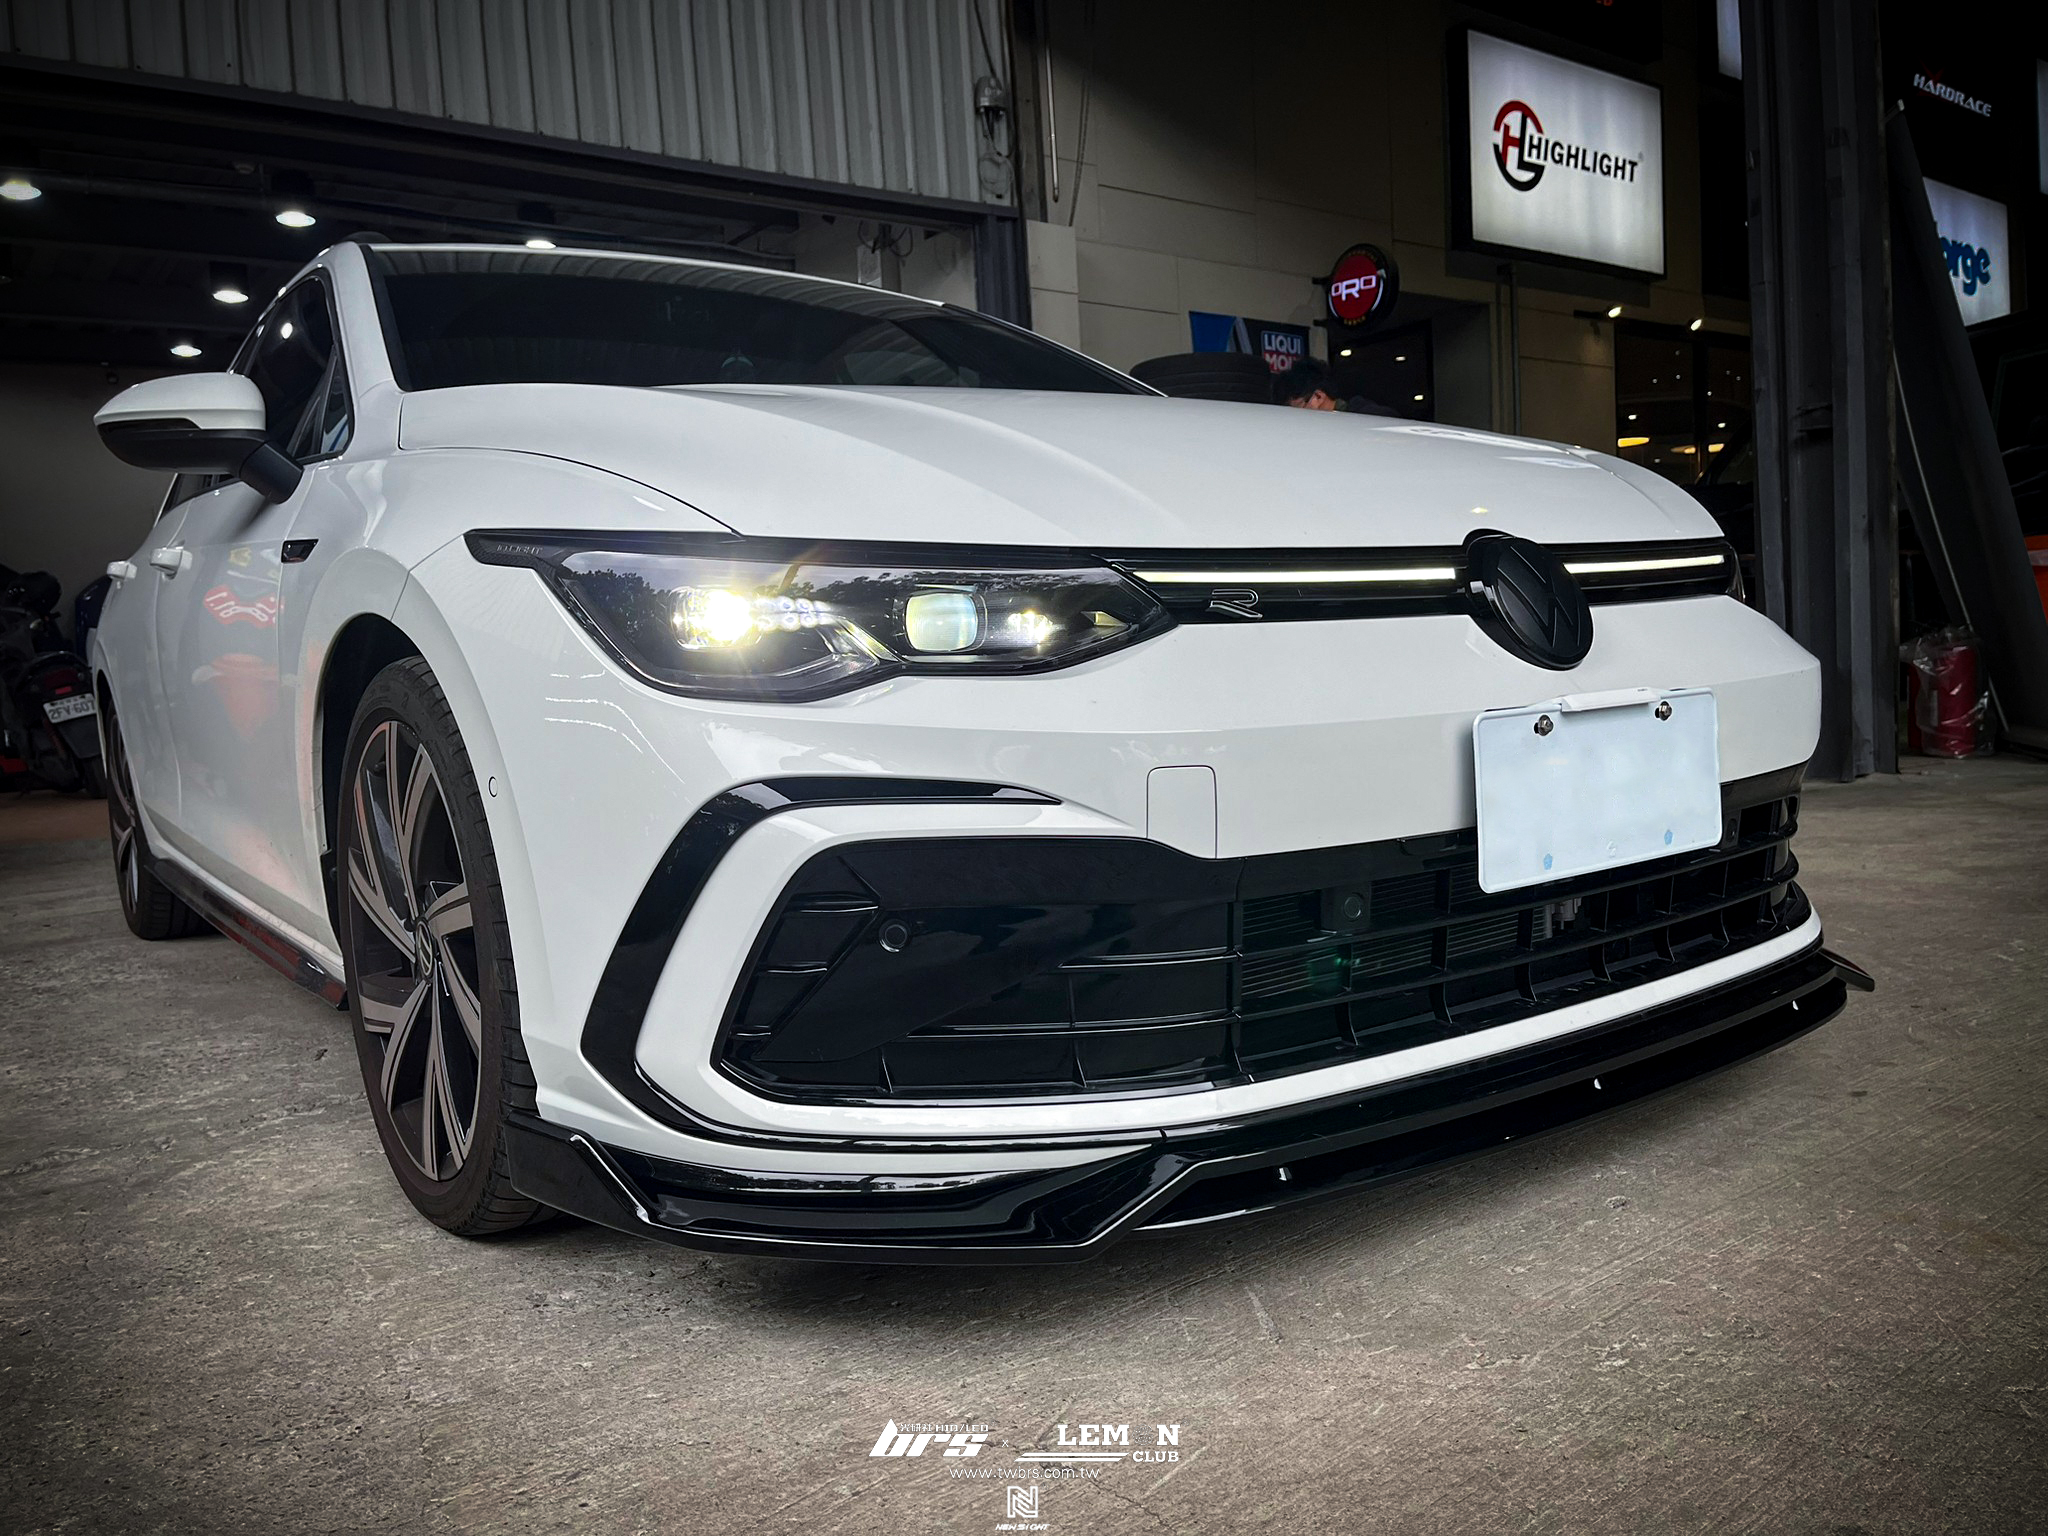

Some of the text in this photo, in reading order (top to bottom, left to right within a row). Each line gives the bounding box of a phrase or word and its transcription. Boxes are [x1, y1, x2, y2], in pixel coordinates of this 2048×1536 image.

[1913, 73, 1992, 118] HARDRACE
[1527, 133, 1638, 183] HIGHLIGHT
[1264, 333, 1301, 355] LIQUI
